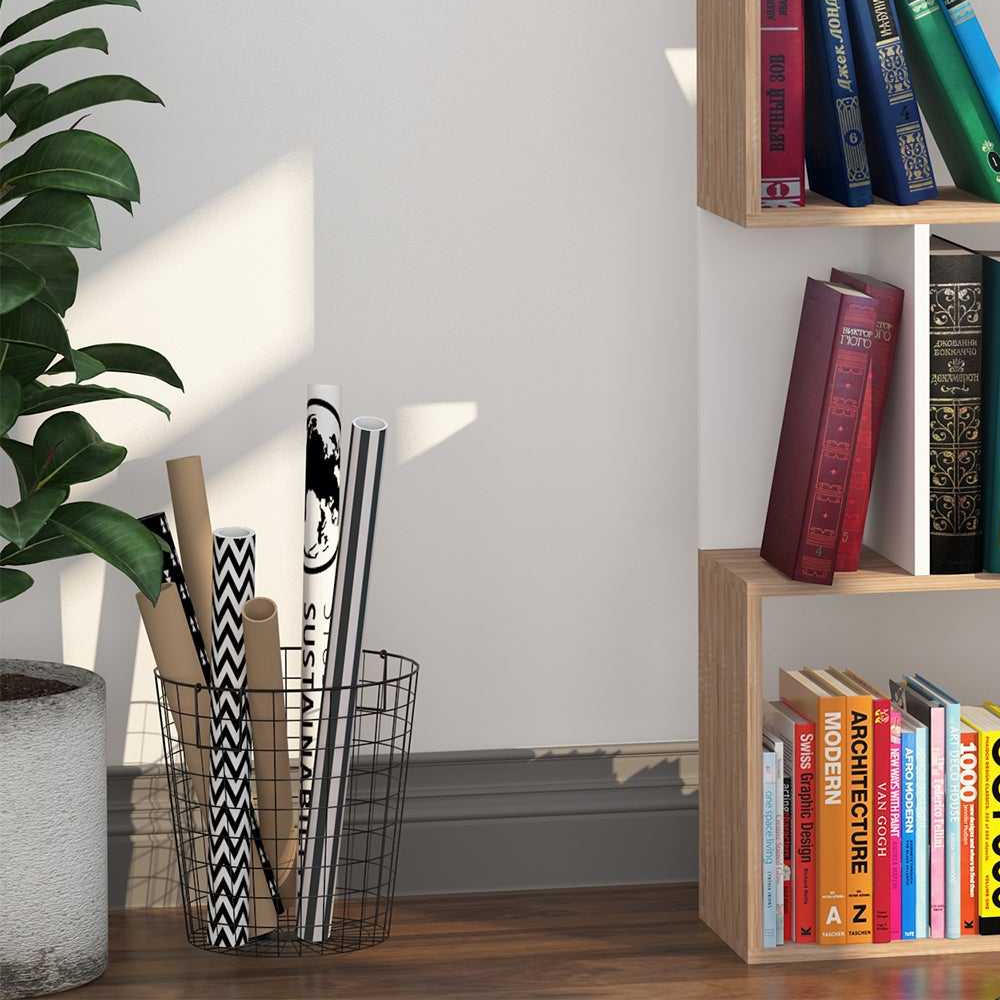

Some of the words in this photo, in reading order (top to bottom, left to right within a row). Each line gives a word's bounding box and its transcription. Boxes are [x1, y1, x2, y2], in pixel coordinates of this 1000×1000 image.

[770, 54, 785, 82] ЗОВ
[836, 47, 853, 92] Джек
[766, 88, 785, 153] ВЕЧНЫЙ
[900, 106, 911, 120] 4
[850, 133, 858, 144] 6
[992, 156, 998, 167] 1
[773, 184, 782, 196] 1
[840, 335, 872, 349] ГЮГО
[843, 327, 873, 338] ВИКТОР
[933, 339, 977, 349] ДЖОВАННИ
[934, 348, 977, 356] БОККАЧЧО
[841, 531, 849, 543] 5
[815, 546, 823, 558] 4
[950, 727, 959, 748] ART
[800, 733, 814, 770] Swiss
[825, 712, 842, 805] MODERN
[890, 748, 899, 766] NEW
[905, 748, 914, 779] AFRO
[890, 767, 899, 789] WAYS
[950, 750, 959, 781] DECO
[960, 742, 977, 802] 1000
[766, 791, 774, 809] one
[798, 773, 813, 819] Graphic
[851, 711, 867, 874] ARCHITECTURE
[877, 782, 886, 810] VAN
[890, 790, 899, 812] WITH
[934, 779, 943, 816] Federico
[950, 785, 959, 822] HOUSE
[905, 782, 914, 833] MODERN
[764, 811, 774, 836] space
[877, 815, 887, 856] GOGH
[890, 814, 900, 837] PAINT
[934, 819, 944, 848] Fellini
[764, 839, 774, 864] living
[798, 822, 813, 863] Design
[826, 906, 842, 924] A
[853, 905, 867, 923] Z
